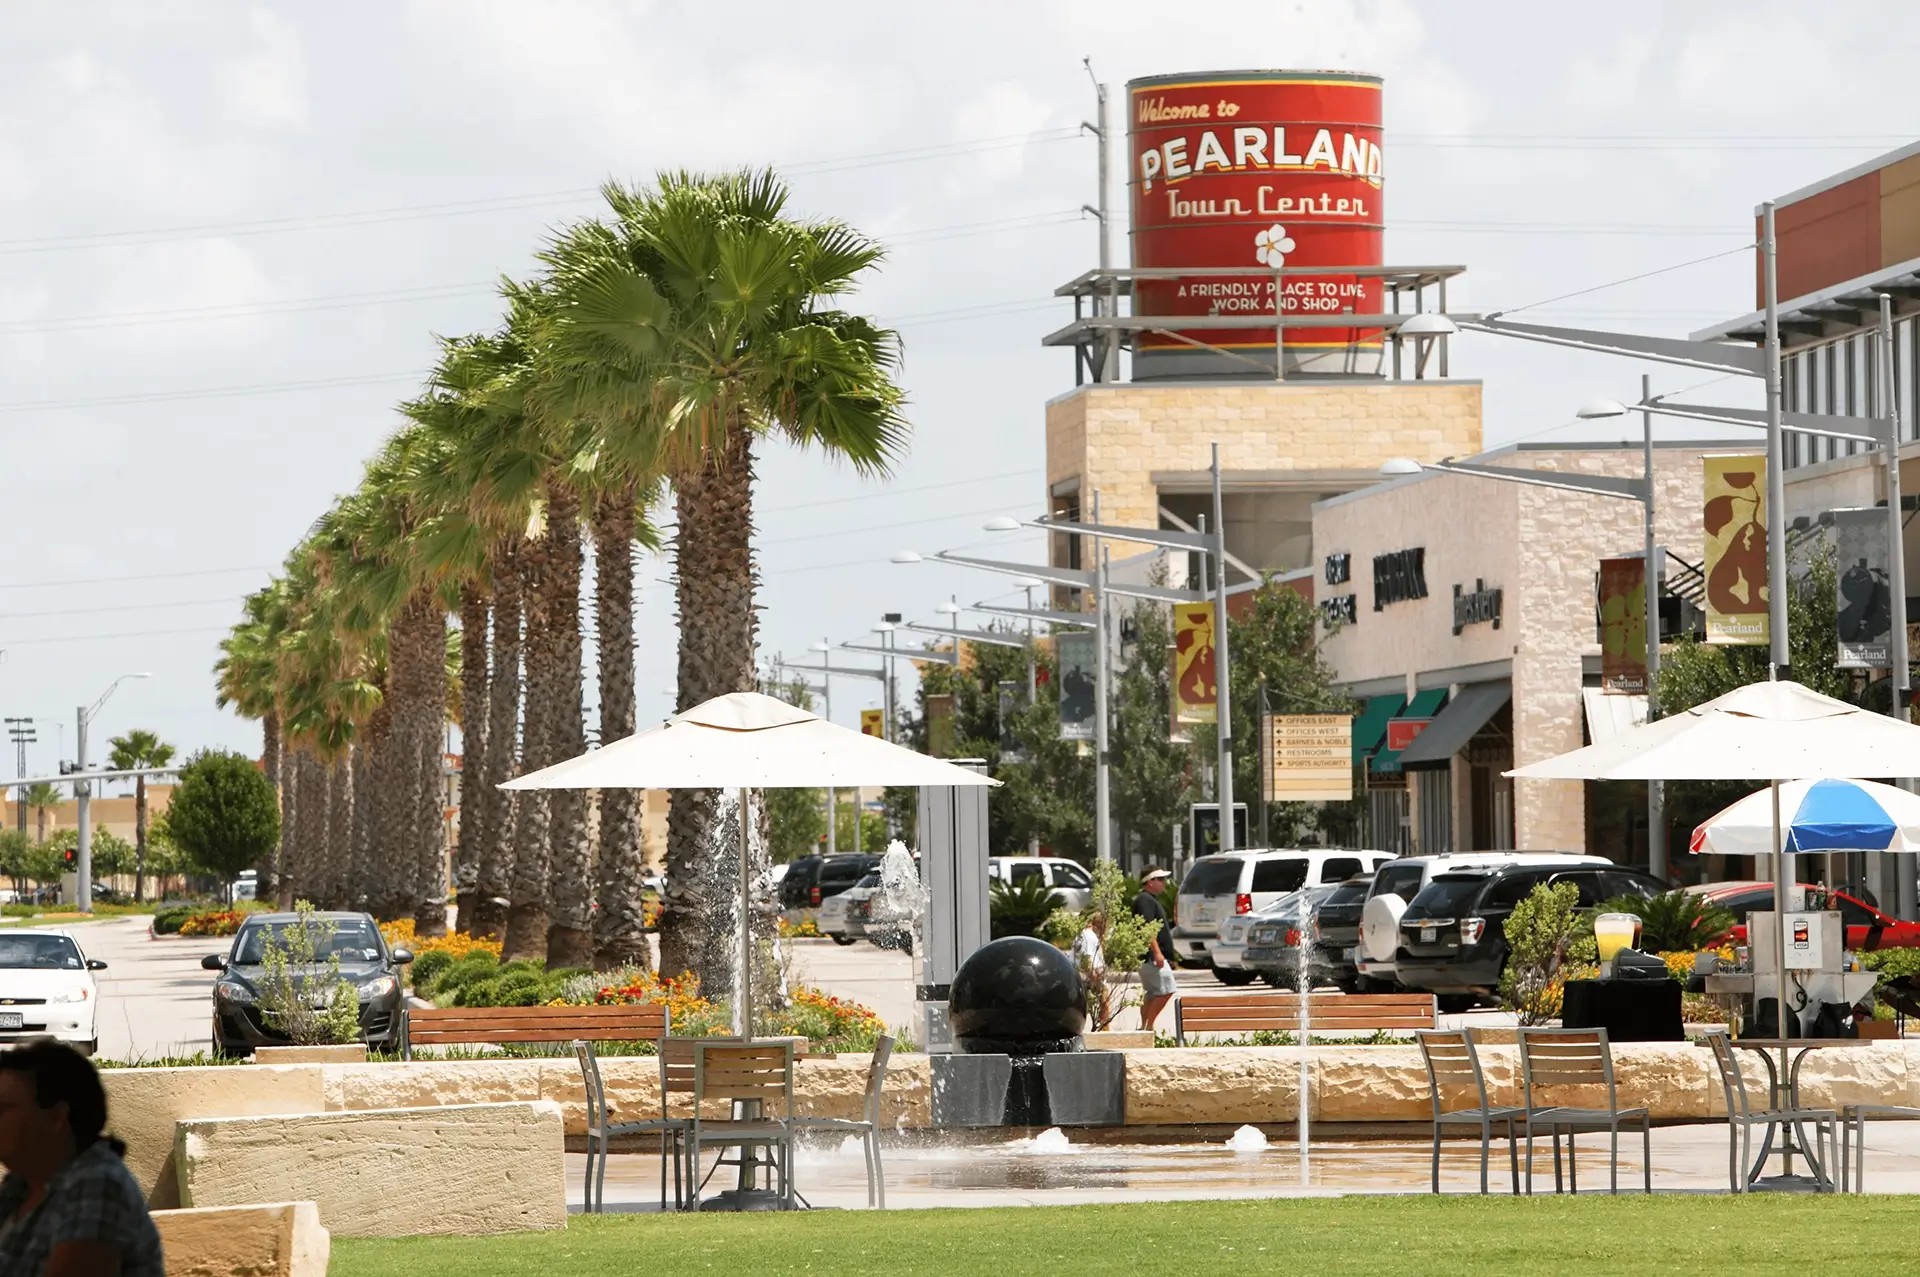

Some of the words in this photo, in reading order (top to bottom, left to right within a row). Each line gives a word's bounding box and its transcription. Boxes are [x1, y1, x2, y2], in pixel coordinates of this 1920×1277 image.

[1139, 97, 1210, 123] Welcome
[1217, 100, 1240, 117] to
[1140, 126, 1383, 195] PEARLAND
[1165, 188, 1252, 219] Town
[1258, 185, 1369, 217] Center
[1178, 284, 1187, 297] A
[1191, 282, 1261, 296] FRIENDLY
[1318, 282, 1338, 296] TO
[1340, 283, 1367, 299] LIVE,
[1212, 297, 1259, 311] WORK
[1302, 296, 1340, 311] SHOP
[1712, 621, 1763, 633] Pearland
[1843, 648, 1887, 660] Pearland
[1606, 677, 1644, 688] Pearland
[1286, 717, 1317, 725] OFFICES
[1318, 717, 1337, 725] EAST
[1286, 738, 1316, 746] BARNES
[1324, 738, 1347, 746] NOBLE
[1286, 749, 1333, 757] RESTROOMS
